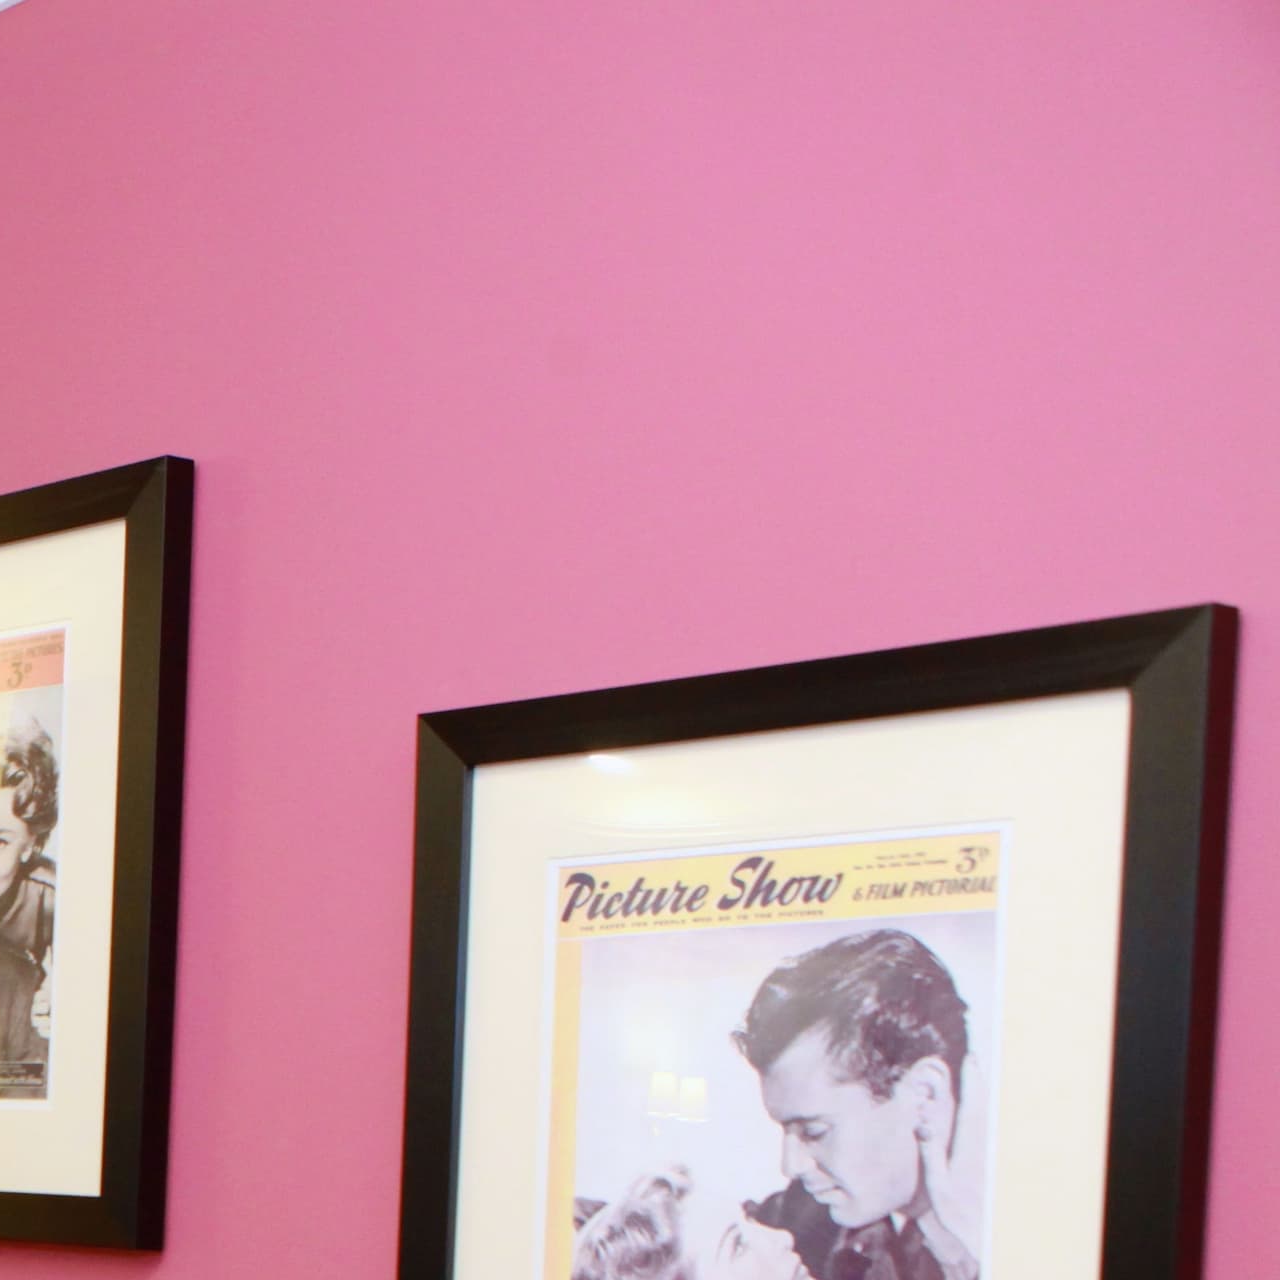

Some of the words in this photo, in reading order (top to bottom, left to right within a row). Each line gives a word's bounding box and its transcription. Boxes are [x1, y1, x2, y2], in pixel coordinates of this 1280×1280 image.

[560, 872, 710, 923] Picture
[716, 856, 846, 910] Show
[866, 881, 907, 900] FILM
[910, 875, 998, 897] PICTORIAL
